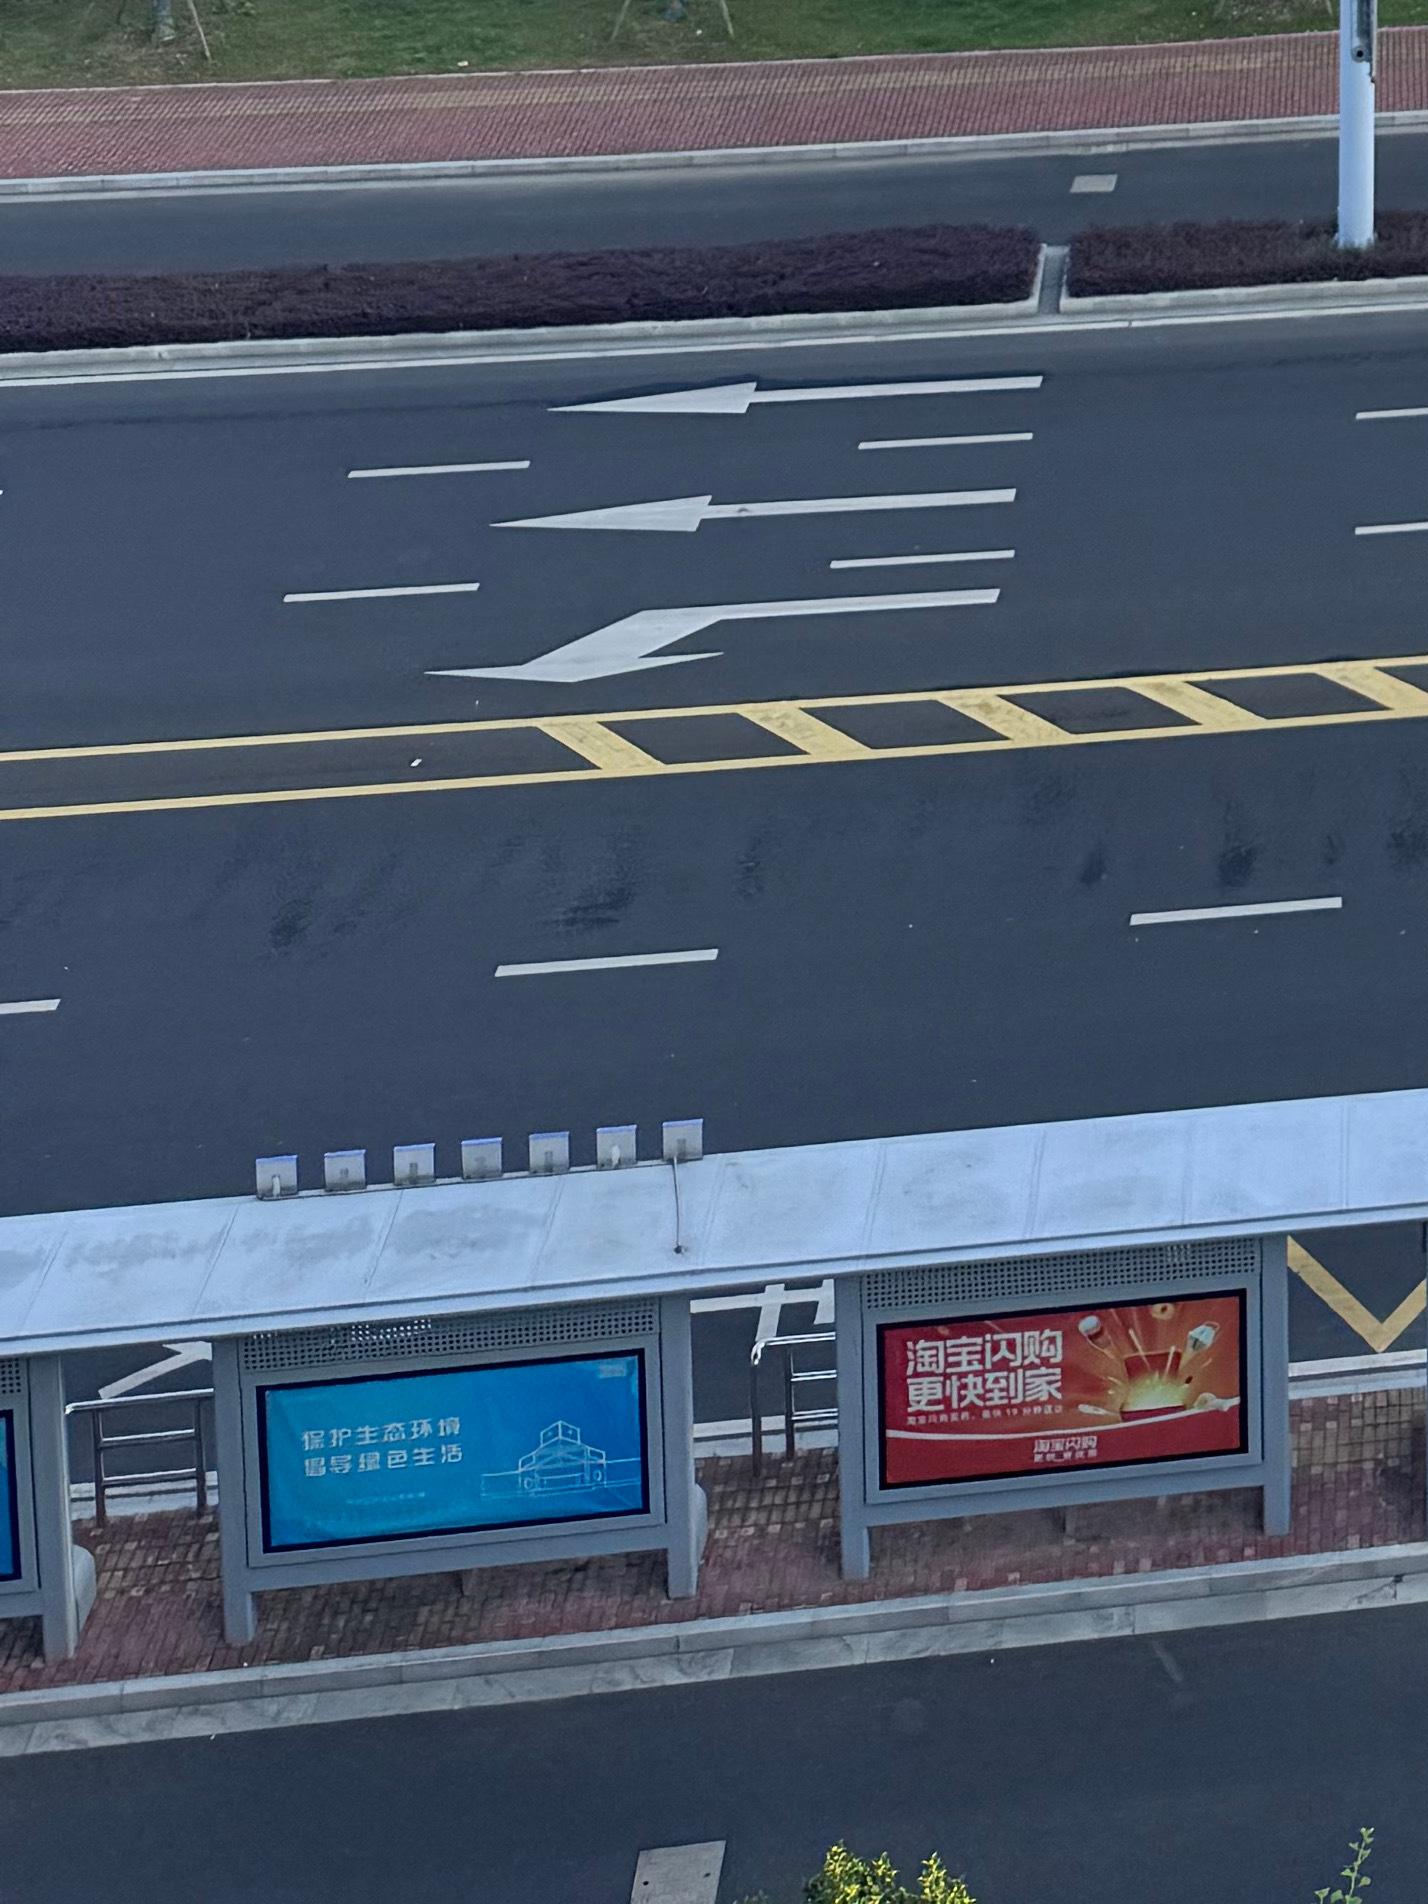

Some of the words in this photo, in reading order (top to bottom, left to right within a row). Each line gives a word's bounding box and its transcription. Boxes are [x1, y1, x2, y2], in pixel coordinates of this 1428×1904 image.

[906, 1328, 1063, 1376] 淘宝闪购
[906, 1366, 1062, 1413] 更快到家
[302, 1417, 460, 1451] 保护生态环境
